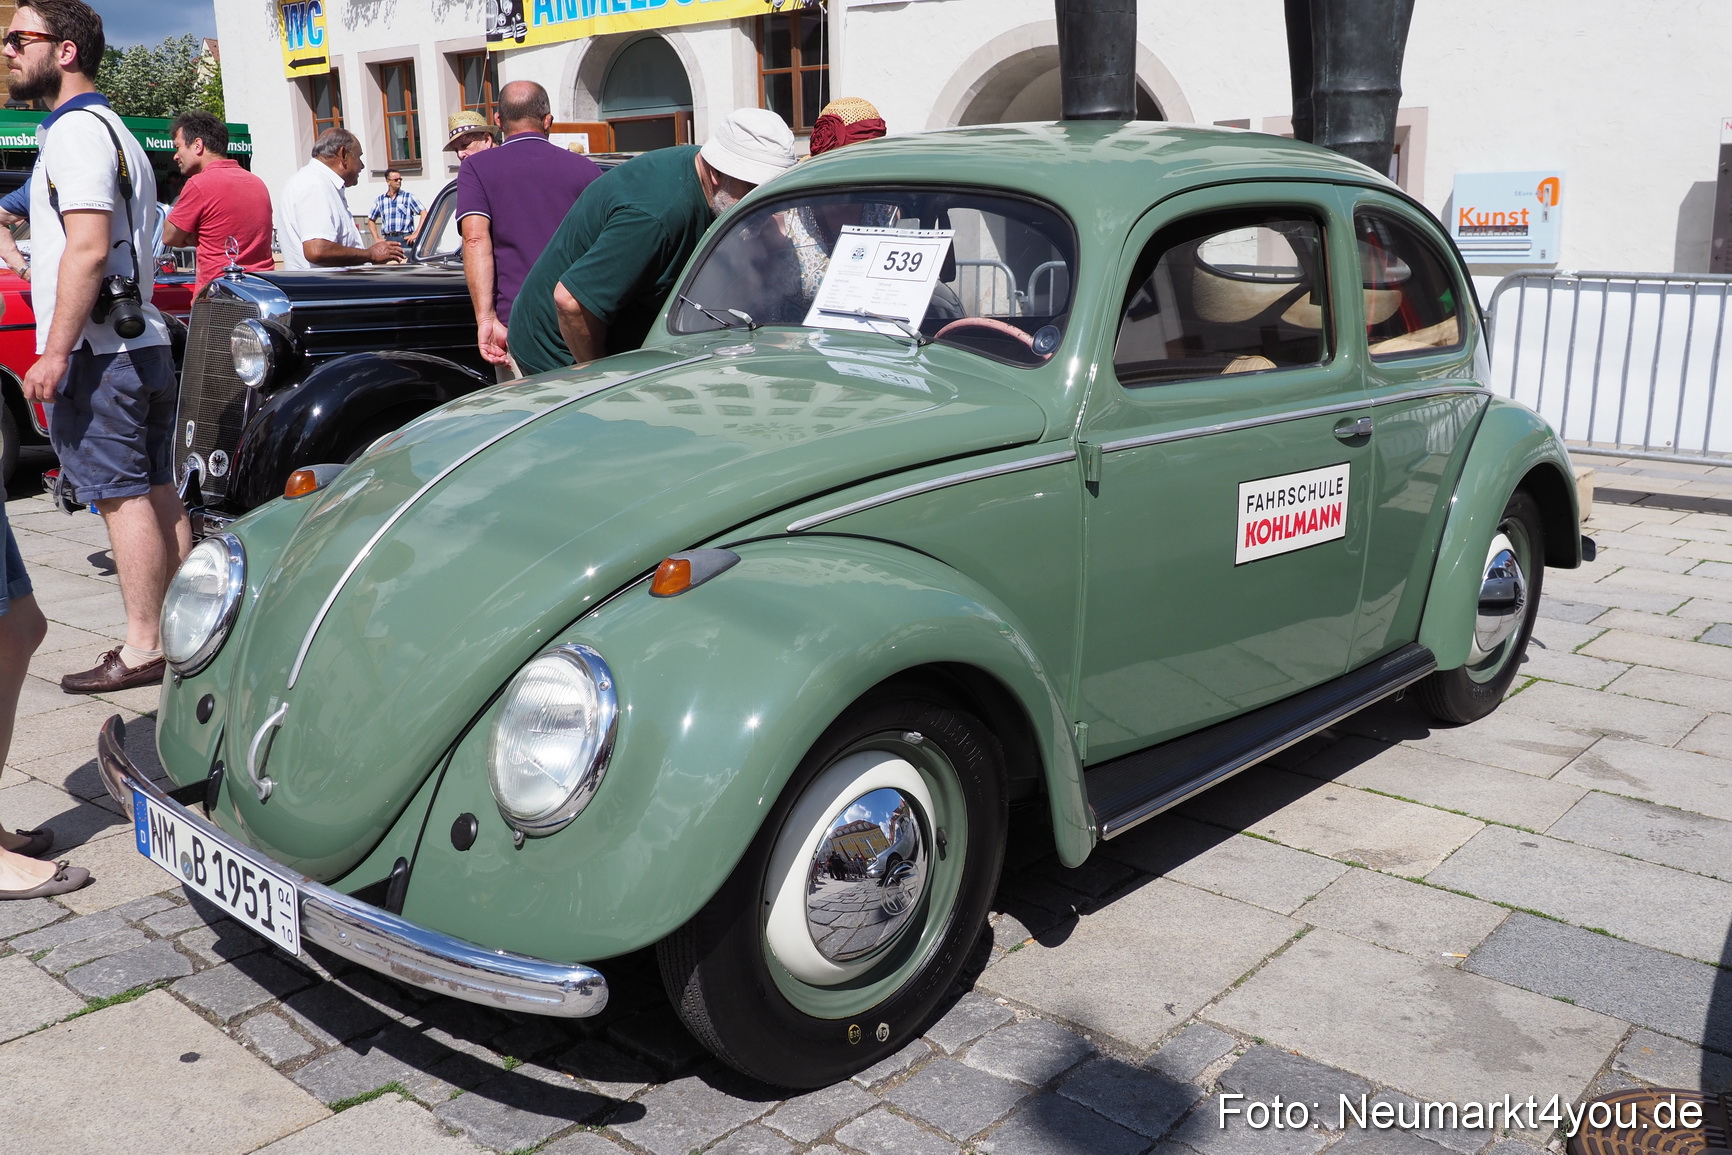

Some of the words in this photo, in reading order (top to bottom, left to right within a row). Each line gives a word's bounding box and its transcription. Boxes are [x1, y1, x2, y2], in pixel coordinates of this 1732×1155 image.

[281, 1, 324, 51] WC
[1459, 207, 1530, 226] Kunst
[883, 250, 923, 273] 539
[1246, 477, 1343, 514] FAHRSCHULE
[1245, 502, 1342, 548] KOHLMANN
[140, 830, 146, 844] D
[149, 806, 177, 869] NM
[277, 887, 292, 907] 04
[281, 924, 293, 943] 10
